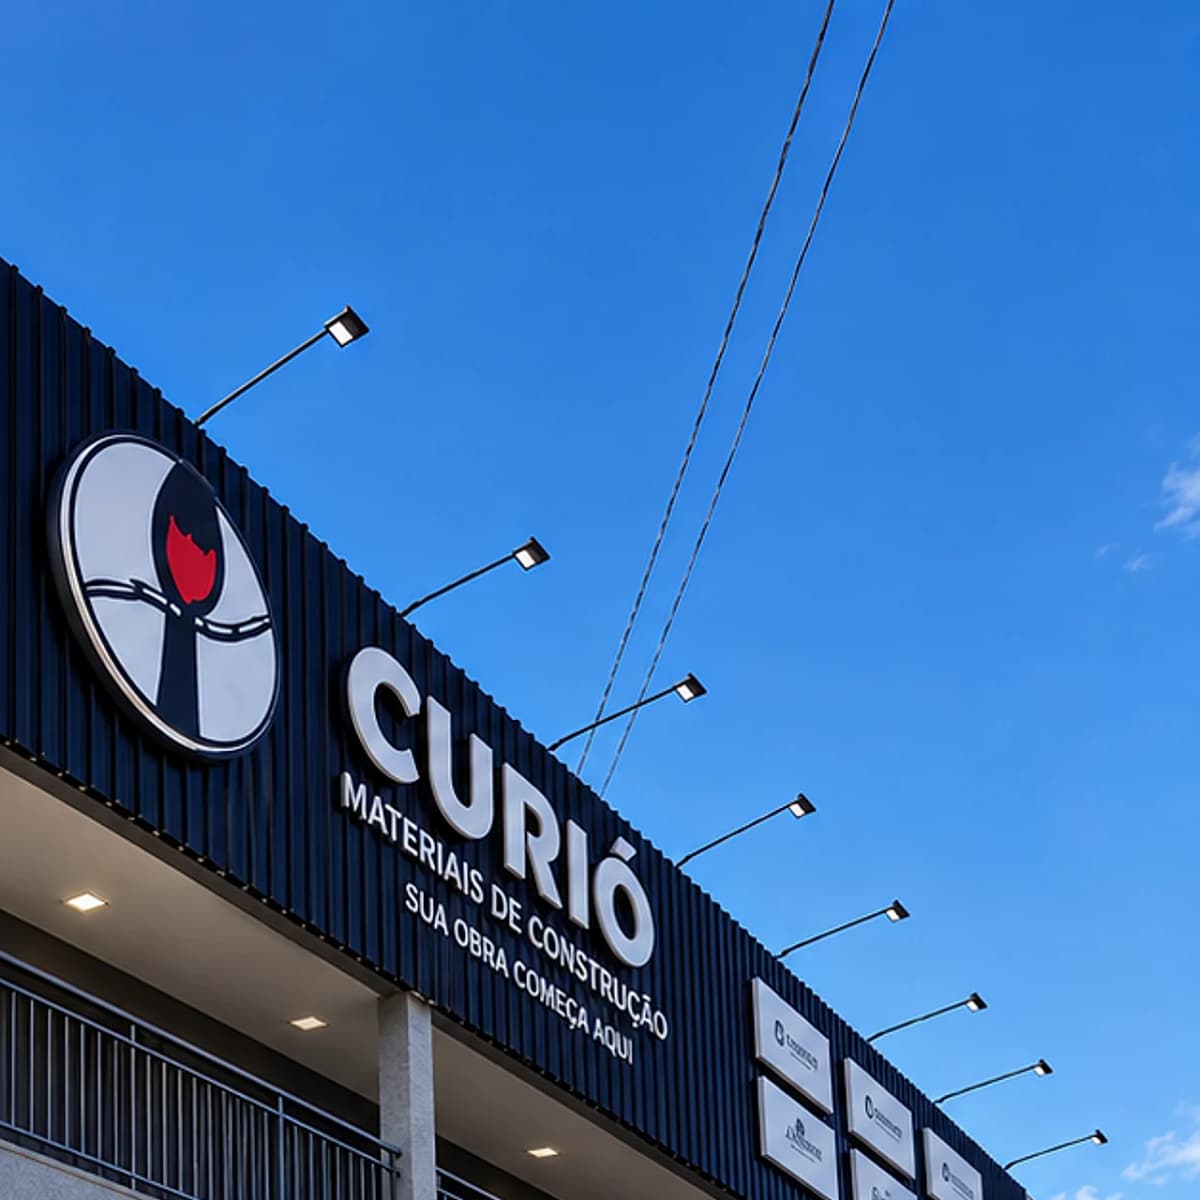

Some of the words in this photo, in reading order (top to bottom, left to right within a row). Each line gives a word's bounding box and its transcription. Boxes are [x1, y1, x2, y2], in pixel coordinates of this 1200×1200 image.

[341, 771, 483, 904] MATERIAIS
[491, 884, 522, 933] DE
[528, 916, 668, 1041] CONSTRUÇÃO
[347, 647, 654, 968] CURIÓ
[405, 884, 449, 936] SUA
[455, 917, 509, 980] OBRA
[513, 960, 590, 1036] COMEÇA
[593, 1018, 634, 1064] AQUI
